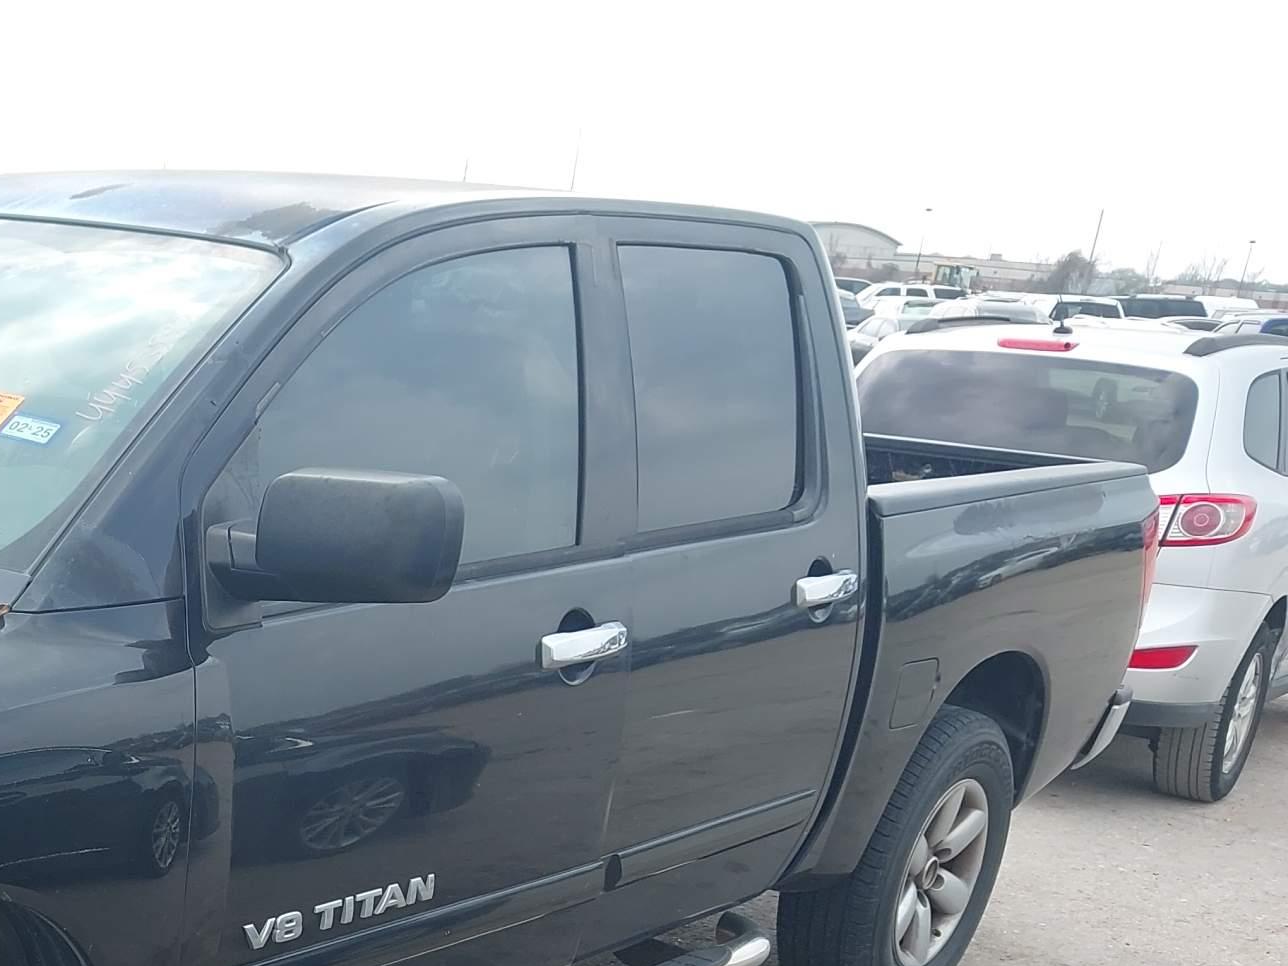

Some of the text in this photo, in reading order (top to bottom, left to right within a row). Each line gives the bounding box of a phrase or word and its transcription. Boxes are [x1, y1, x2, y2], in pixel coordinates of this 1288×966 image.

[9, 420, 53, 438] 02 25
[242, 873, 436, 950] V8 TITAN
